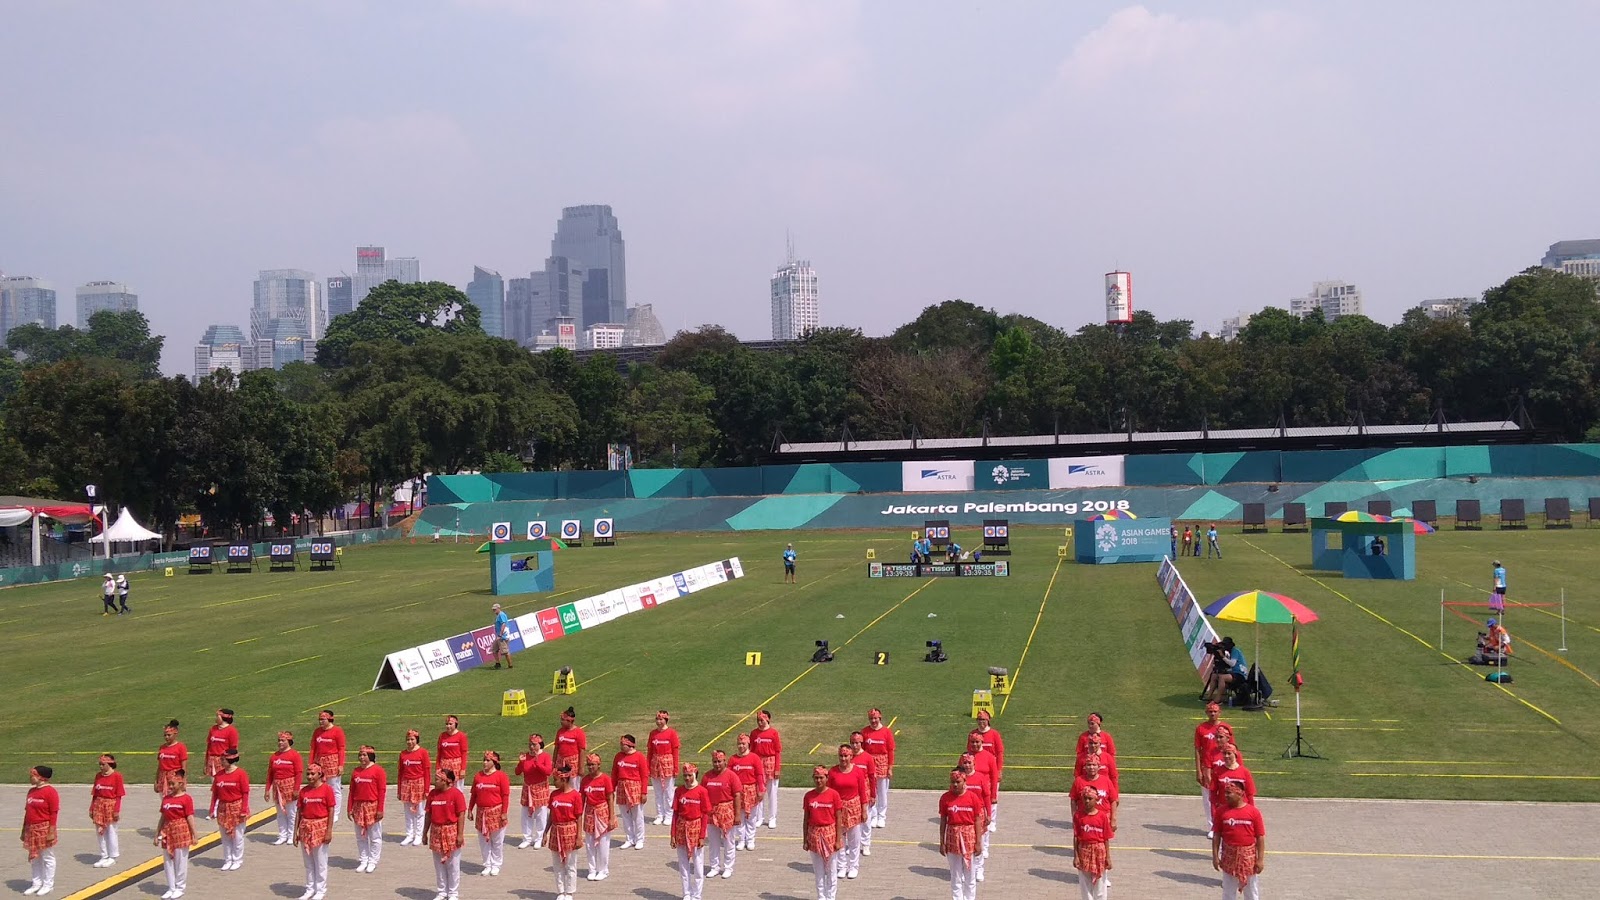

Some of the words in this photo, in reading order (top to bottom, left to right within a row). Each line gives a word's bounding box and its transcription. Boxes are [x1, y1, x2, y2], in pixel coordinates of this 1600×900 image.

[329, 280, 342, 288] citi
[881, 504, 958, 514] Jakarta
[964, 502, 1077, 514] Palembang
[1082, 500, 1130, 512] 2018
[1121, 529, 1144, 537] ASIAN
[1144, 528, 1171, 536] GAMES
[563, 609, 576, 623] Grab
[477, 633, 496, 650] QATAR
[429, 655, 452, 669] TISSOT
[750, 654, 757, 664] 1
[878, 653, 886, 665] 2
